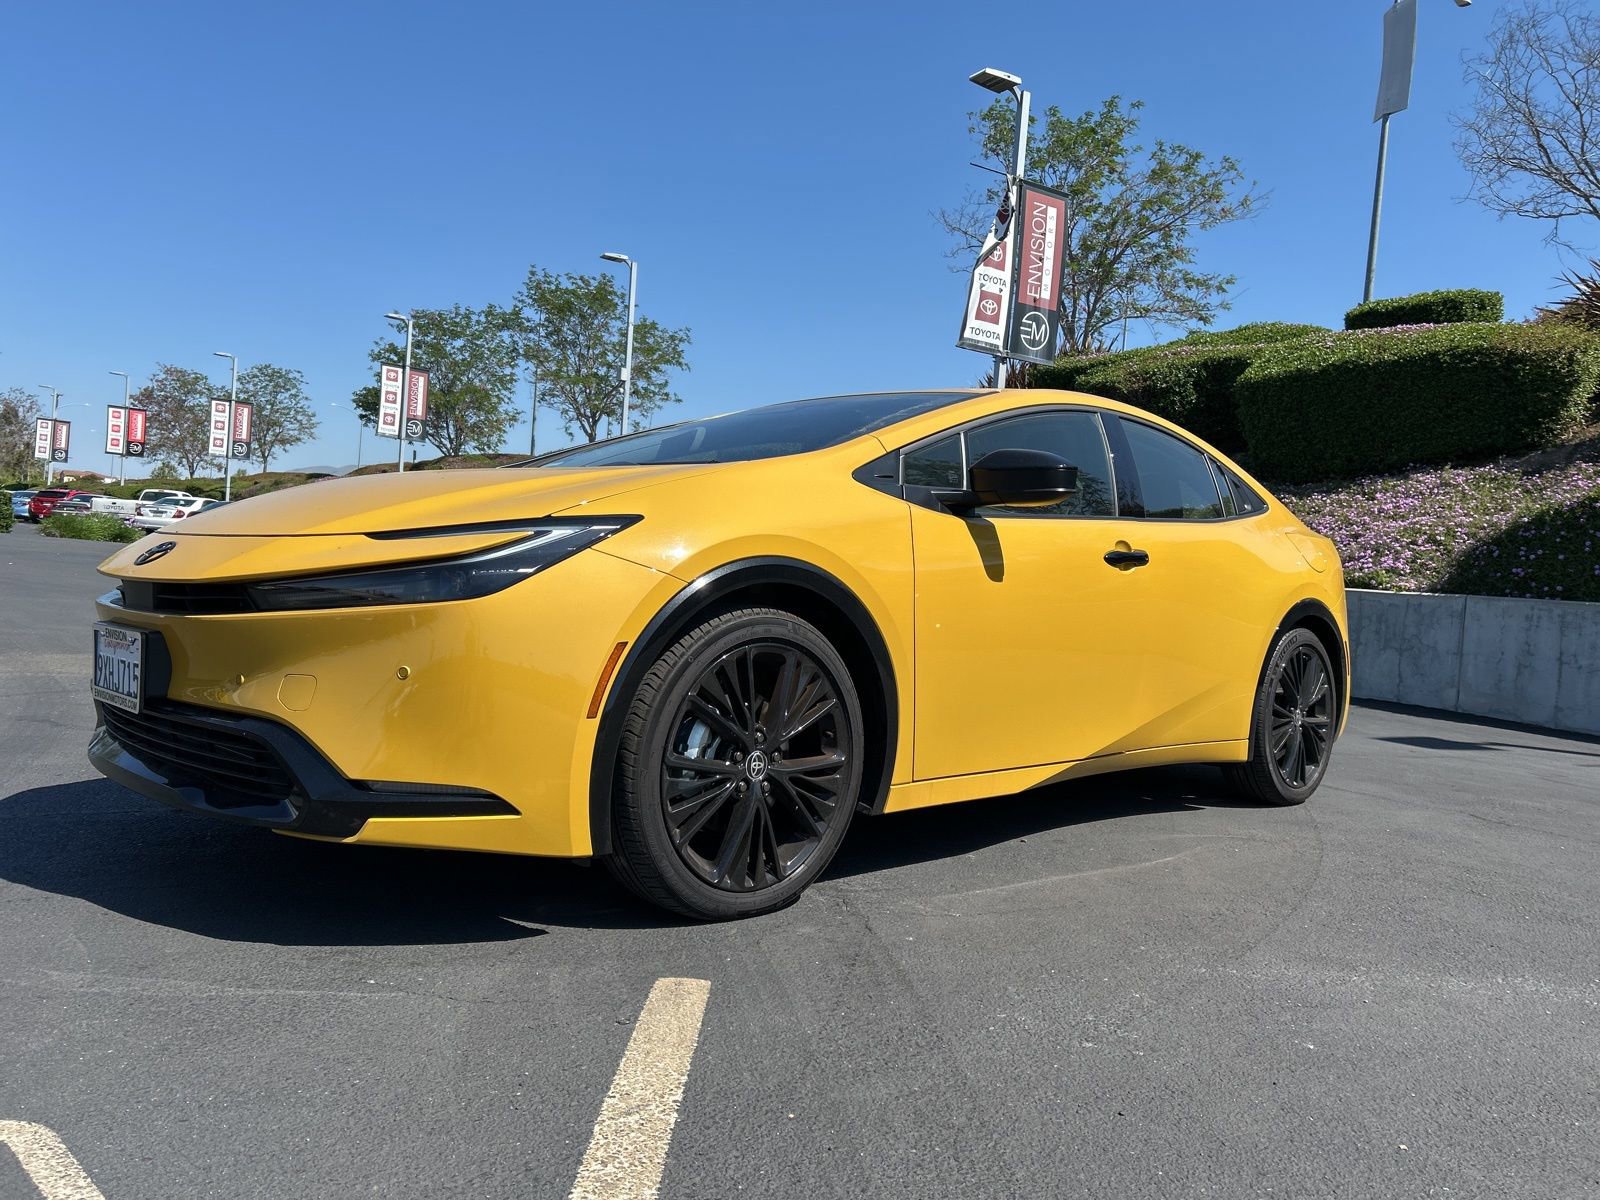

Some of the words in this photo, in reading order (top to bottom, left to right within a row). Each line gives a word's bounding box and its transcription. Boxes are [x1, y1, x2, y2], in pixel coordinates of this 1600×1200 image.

[1027, 202, 1047, 299] ENVISION
[1043, 214, 1055, 292] MOTORS
[978, 273, 1006, 288] TOYOTA
[969, 326, 1000, 341] TOYOTA
[409, 374, 419, 416] ENVISION
[105, 628, 128, 642] ENVISION
[97, 653, 139, 698] 9XHJ715
[94, 688, 138, 710] ENVISIONMOTORS.COM
